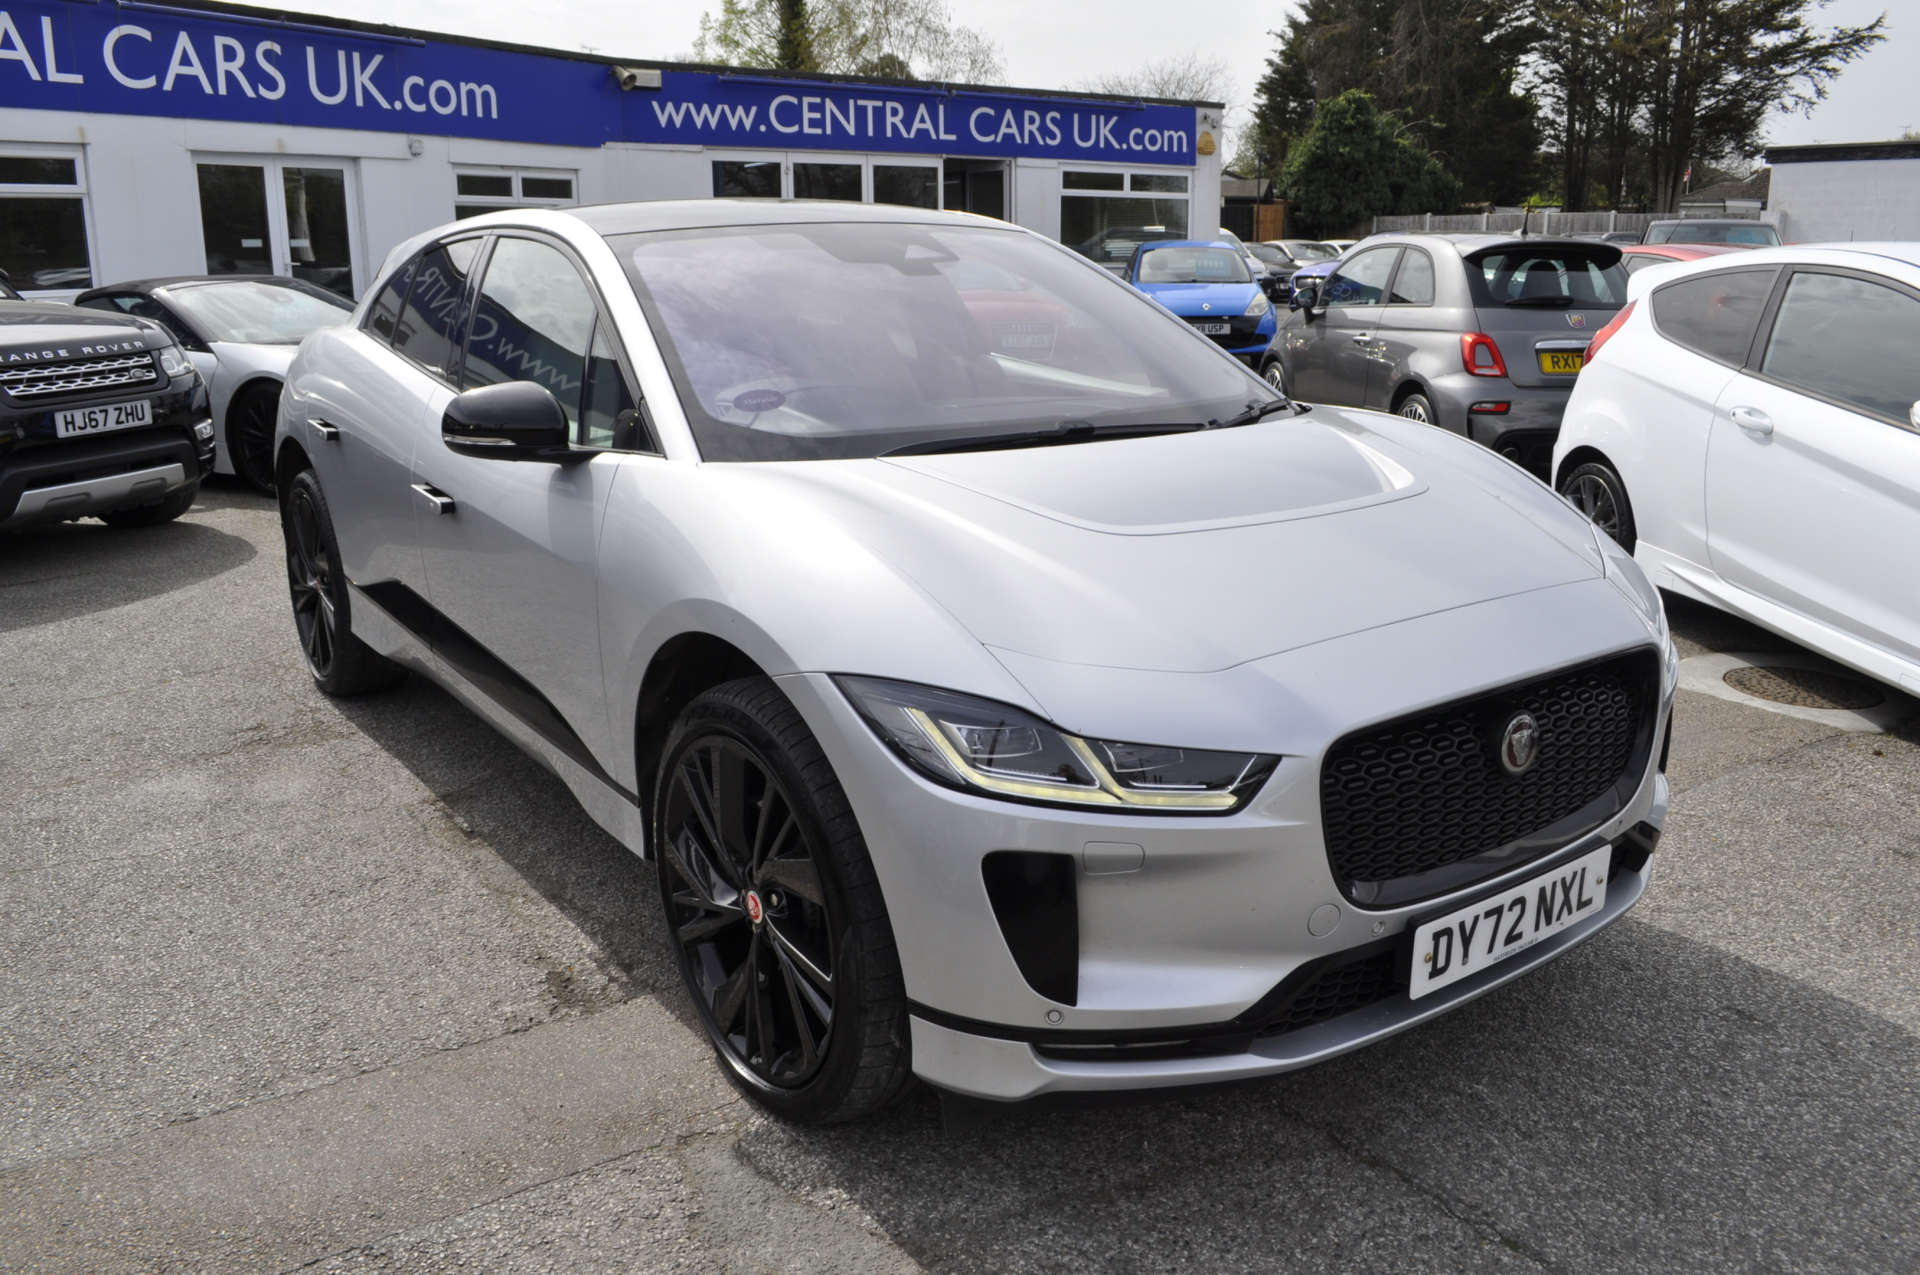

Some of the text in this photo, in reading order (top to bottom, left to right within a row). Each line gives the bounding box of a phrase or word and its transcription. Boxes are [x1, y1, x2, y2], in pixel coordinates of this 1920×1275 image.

[0, 11, 498, 119] AL CARS UK.com
[651, 94, 1187, 153] www.CENTRAL CARS UK.com
[81, 341, 144, 355] ROVER
[1551, 354, 1584, 369] RX17
[63, 403, 146, 433] HJ67 ZHU
[1428, 866, 1593, 980] DY72 NXL
